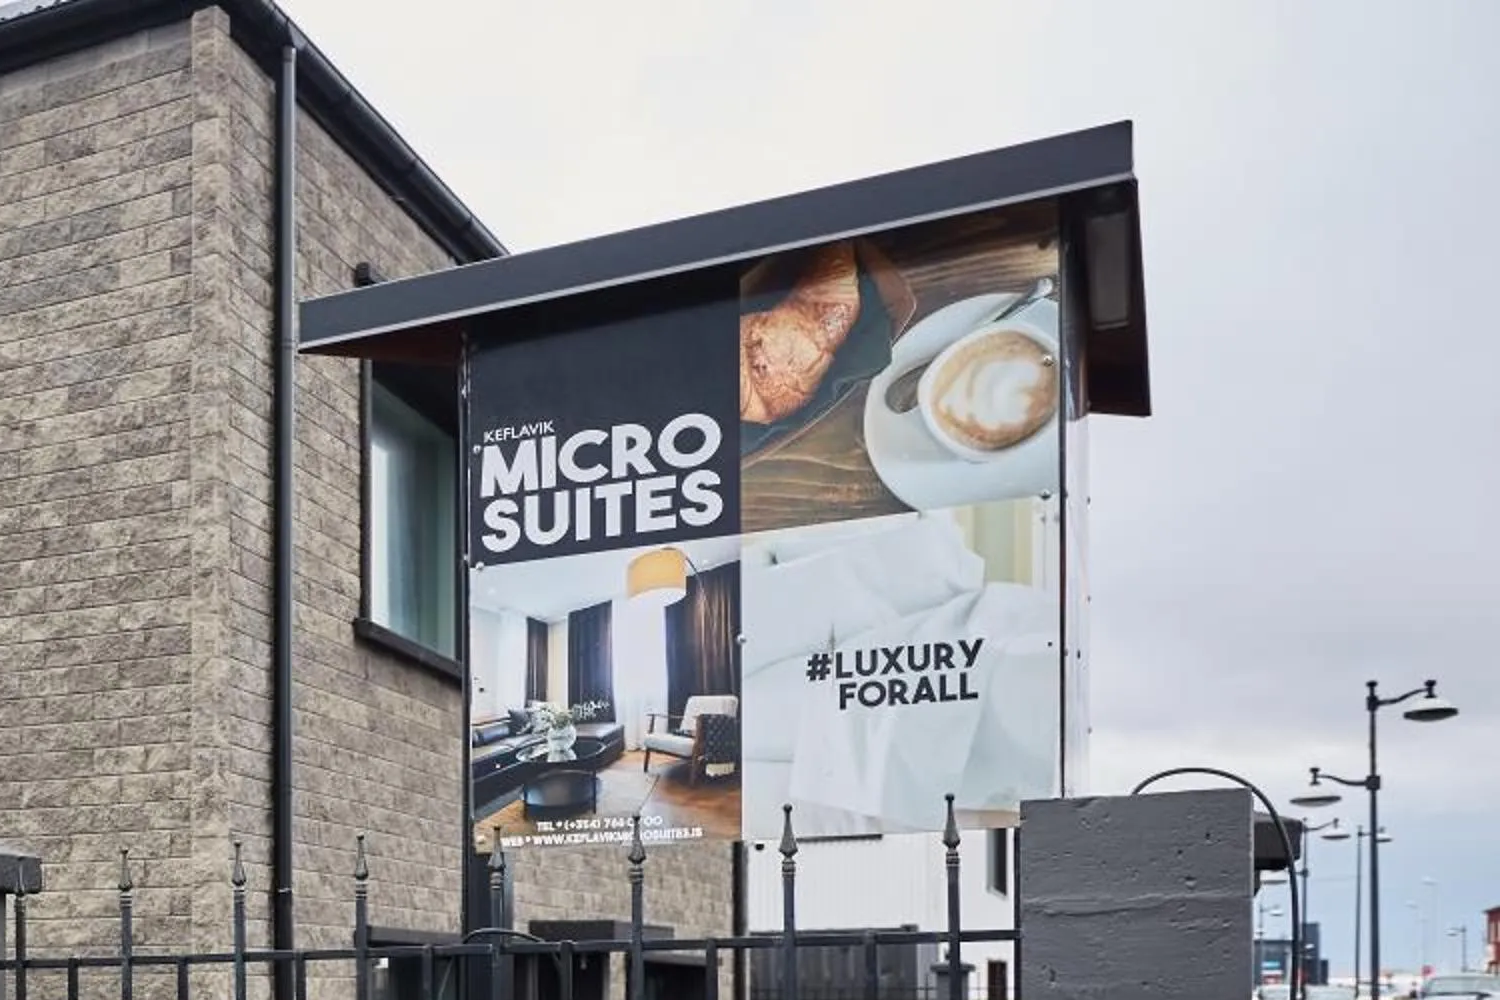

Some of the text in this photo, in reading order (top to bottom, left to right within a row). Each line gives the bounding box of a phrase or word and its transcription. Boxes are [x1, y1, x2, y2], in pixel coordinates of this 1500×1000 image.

[480, 413, 722, 498] MICRO
[483, 420, 555, 444] KEFLAVIK
[481, 469, 724, 552] SUITES
[806, 638, 985, 681] #LUXURY
